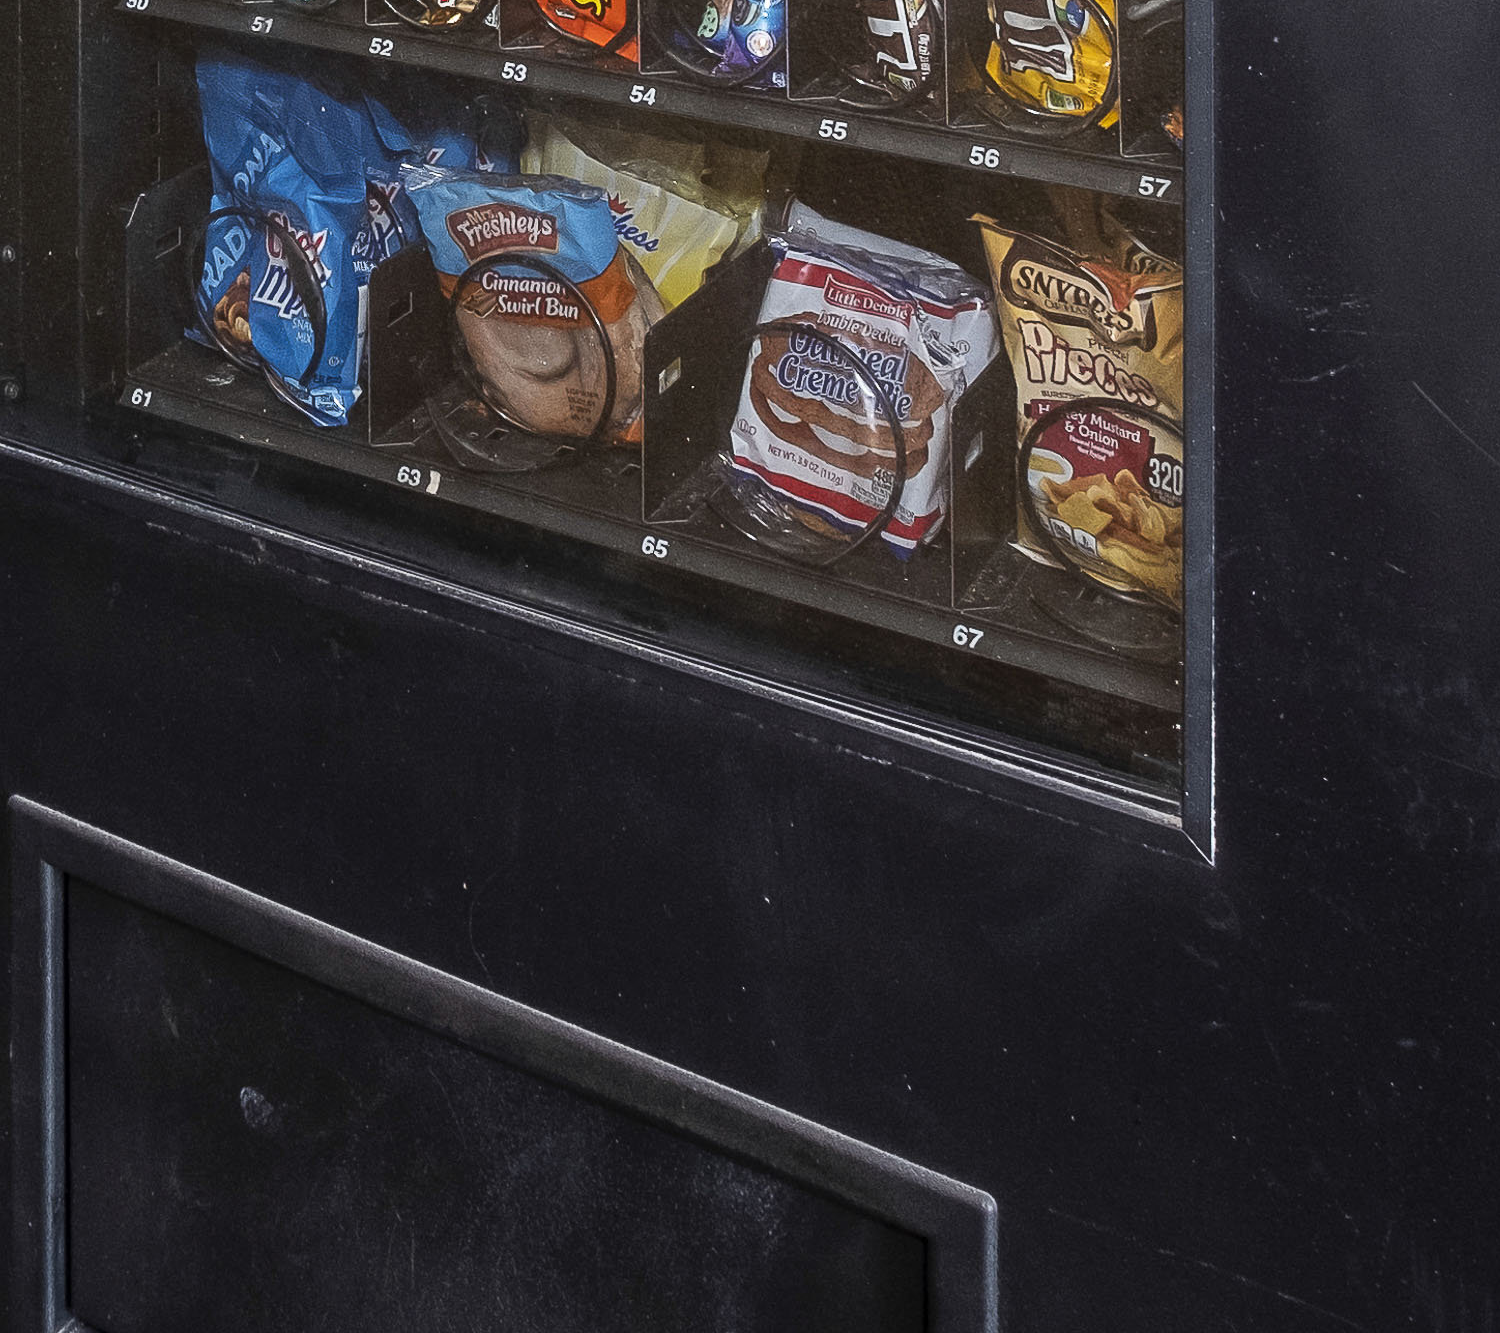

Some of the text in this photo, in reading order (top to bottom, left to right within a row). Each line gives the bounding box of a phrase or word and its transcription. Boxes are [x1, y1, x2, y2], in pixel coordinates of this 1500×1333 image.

[251, 17, 274, 33] 51
[369, 38, 394, 56] 52
[502, 63, 527, 82] 53
[630, 86, 657, 105] 54
[819, 121, 848, 140] 55
[970, 147, 1000, 167] 56
[1138, 178, 1171, 196] 57
[457, 211, 553, 247] Freshley's
[498, 294, 578, 319] Swirl Bun
[826, 287, 908, 320] Little Debbie
[818, 310, 906, 347] Double Decker
[1088, 337, 1130, 365] Pretzel
[778, 354, 857, 403] Creme
[131, 388, 152, 407] 61
[1064, 421, 1075, 432] &
[1079, 424, 1119, 450] Onion
[1090, 412, 1141, 443] Mustard
[396, 466, 422, 487] 63
[1149, 457, 1182, 496] 320
[641, 536, 668, 555] 65
[953, 625, 984, 647] 67
